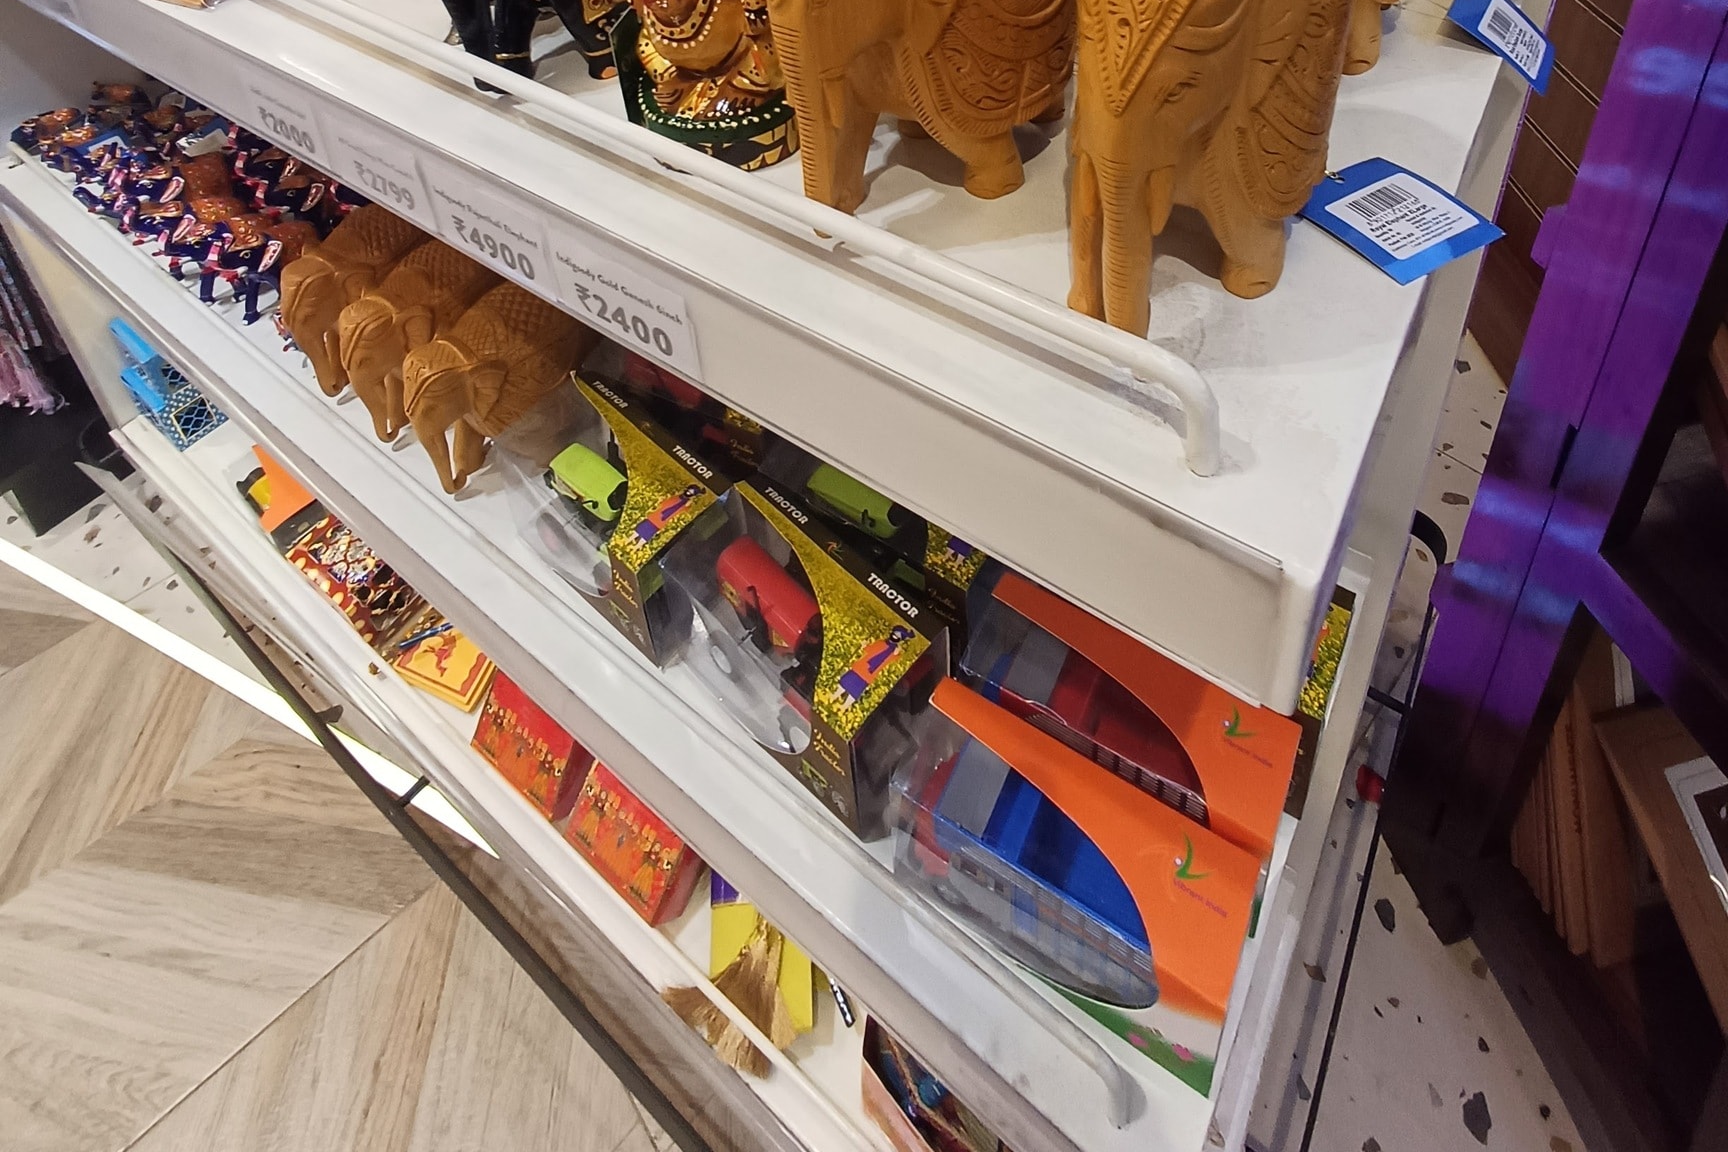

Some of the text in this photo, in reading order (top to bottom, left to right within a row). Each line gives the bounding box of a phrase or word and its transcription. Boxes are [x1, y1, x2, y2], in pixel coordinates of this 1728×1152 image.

[352, 159, 416, 211] ₹2799
[451, 214, 536, 281] ₹4900
[574, 282, 674, 357] ₹2400
[592, 380, 629, 409] TRACTOR
[672, 444, 714, 480] TRACTOR
[764, 486, 809, 525] TRACTOR
[867, 572, 919, 619] TRACTOR
